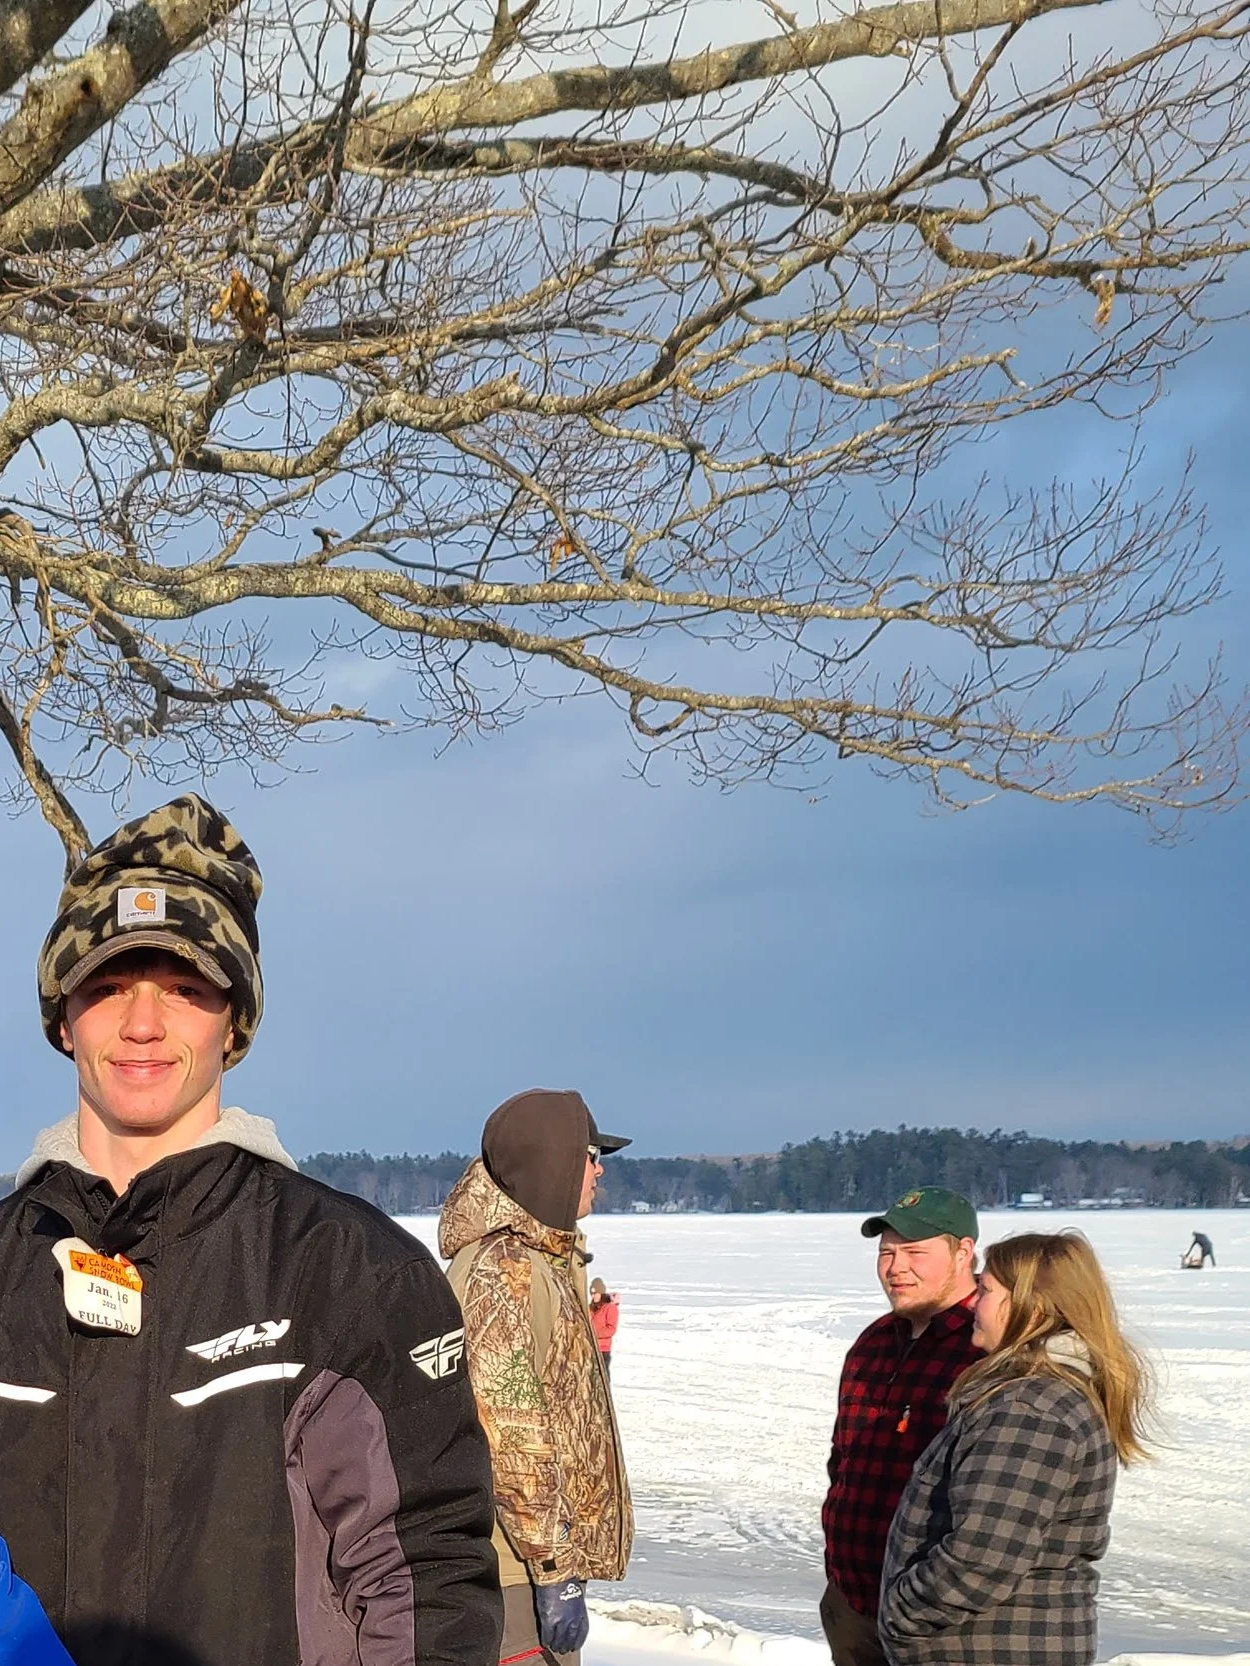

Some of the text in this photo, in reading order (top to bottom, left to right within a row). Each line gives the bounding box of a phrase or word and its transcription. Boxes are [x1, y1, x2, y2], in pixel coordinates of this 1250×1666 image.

[88, 1282, 129, 1304] Jan. 16
[78, 1310, 136, 1333] FULL DAY
[195, 1319, 291, 1357] FLY
[211, 1340, 277, 1363] RACING
